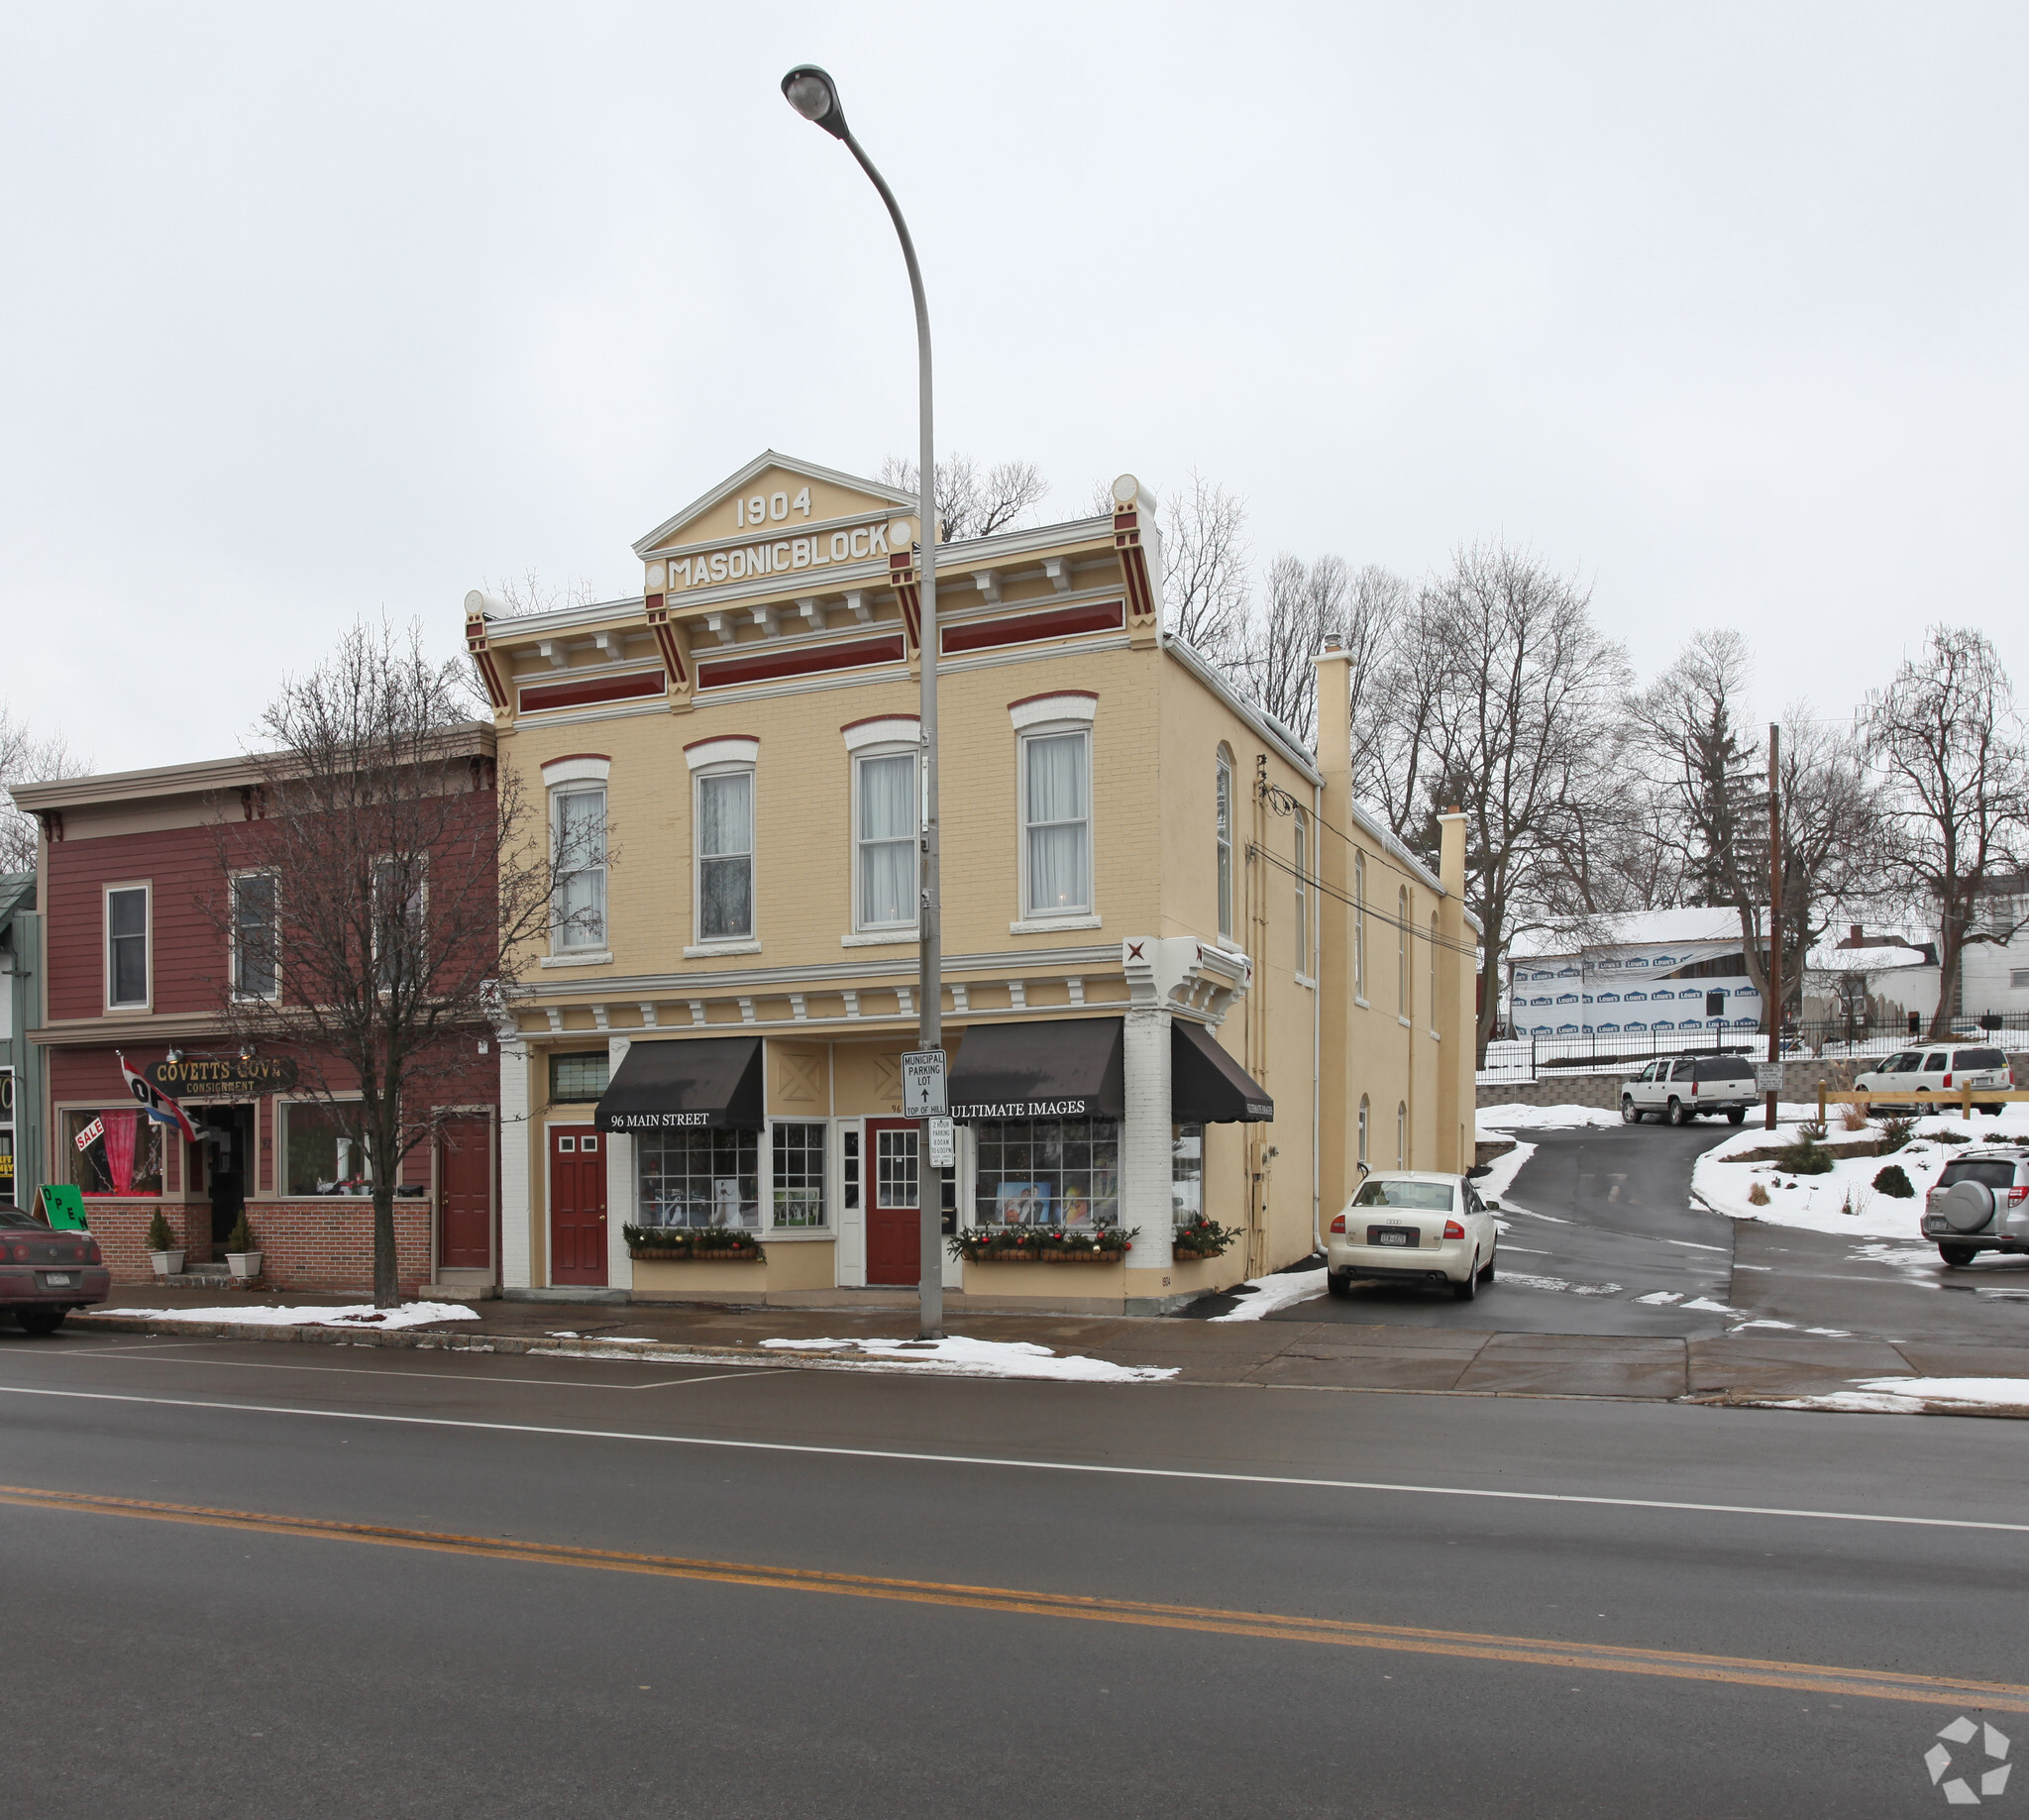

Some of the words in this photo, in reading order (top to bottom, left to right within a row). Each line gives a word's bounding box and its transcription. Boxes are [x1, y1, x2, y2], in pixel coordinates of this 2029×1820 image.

[738, 487, 810, 528] 1904
[905, 1054, 942, 1065] MUNICIPAL
[158, 1062, 230, 1081] COVETTS
[909, 1065, 940, 1076] PARKING
[918, 1076, 930, 1085] LOT
[186, 1081, 255, 1093] CONSIGNMENT
[892, 1105, 901, 1114] 96
[951, 1104, 1024, 1118] ULTIMATE
[1028, 1101, 1085, 1115] IMAGES
[611, 1116, 624, 1126] 96
[627, 1115, 660, 1126] MAIN
[662, 1114, 709, 1125] STREET
[77, 1121, 102, 1148] SALE
[44, 1189, 89, 1230] OPEN
